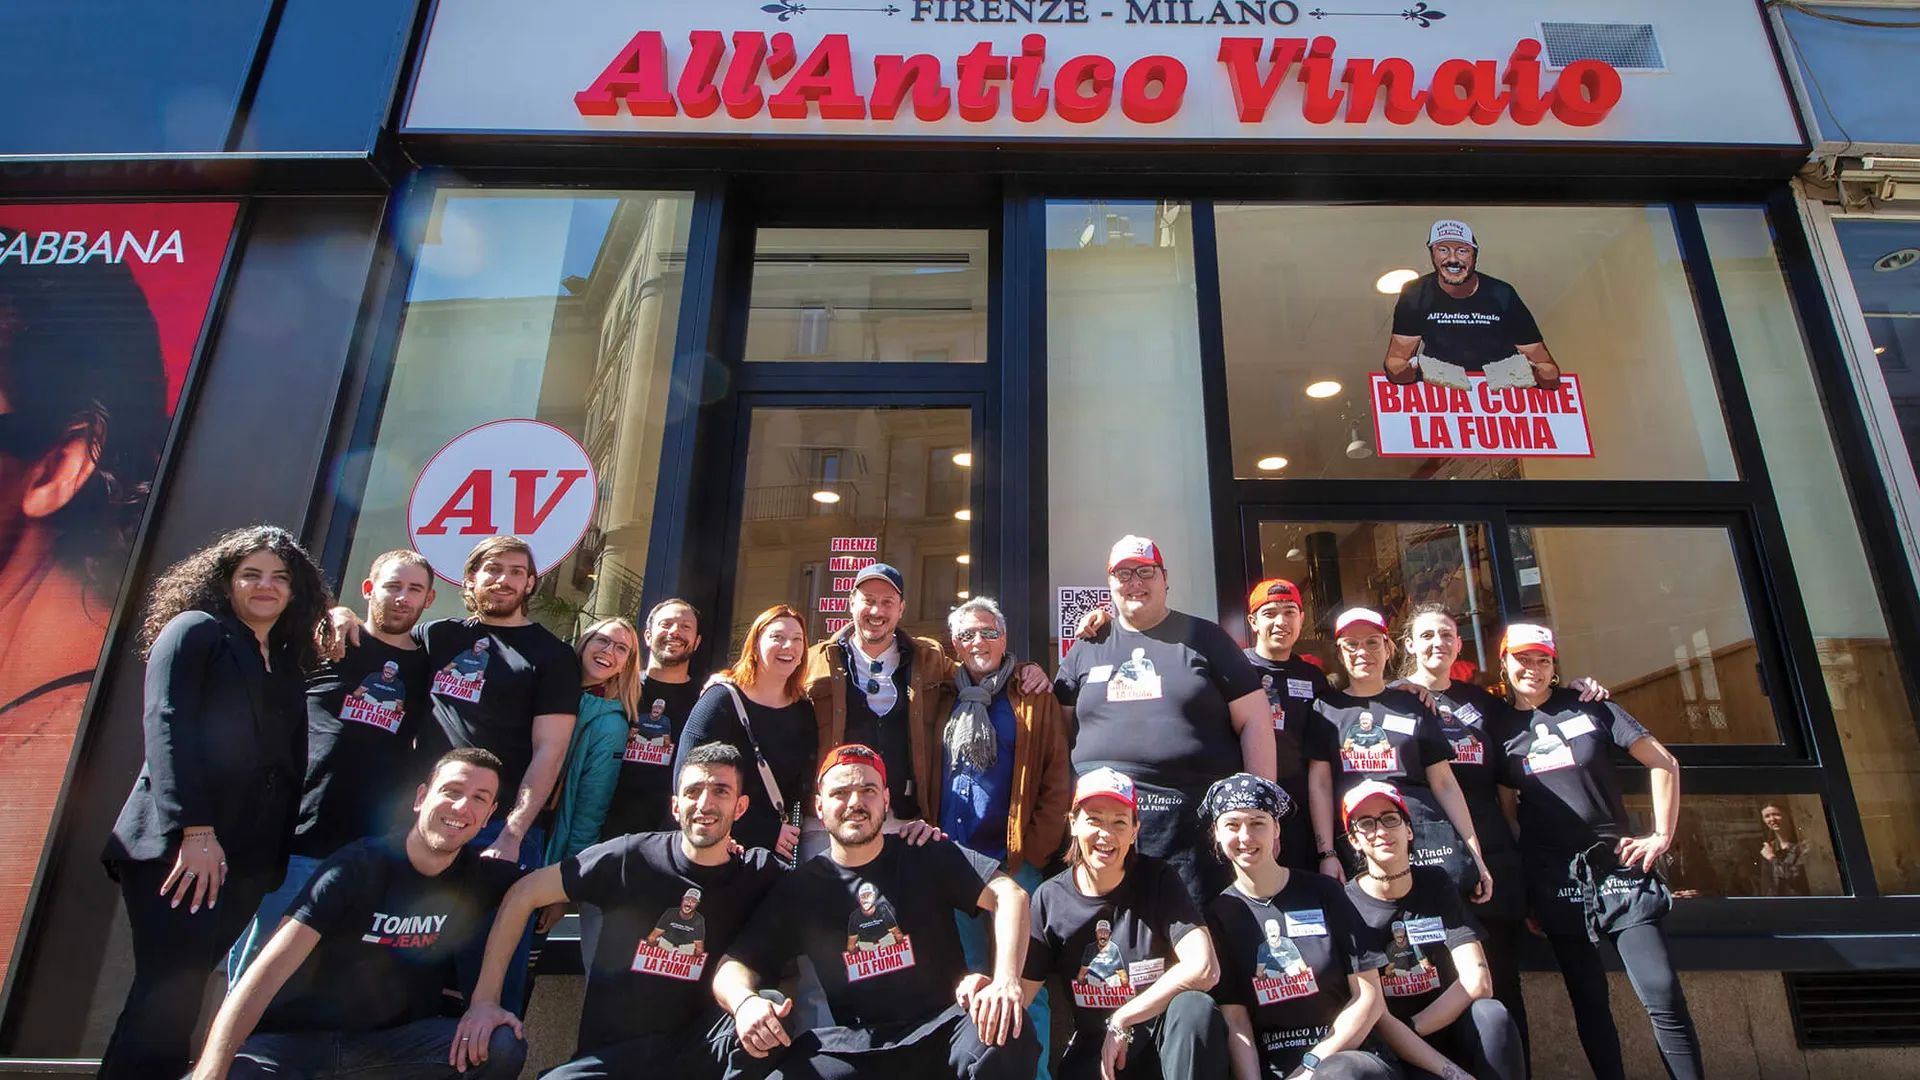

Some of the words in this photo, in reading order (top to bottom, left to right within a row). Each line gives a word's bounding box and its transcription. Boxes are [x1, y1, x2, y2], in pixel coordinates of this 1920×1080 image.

[910, 0, 1090, 23] FIRENZE
[1125, 0, 1300, 25] MILANO
[574, 30, 1188, 124] All'Antico
[1217, 36, 1623, 127] Vinaio
[1377, 381, 1473, 414] BADA
[1410, 416, 1453, 449] LA
[1457, 416, 1558, 449] FUMA
[416, 469, 588, 535] AV
[831, 537, 877, 551] FIRENZE
[819, 598, 847, 612] NEW
[1147, 794, 1183, 805] Vinaio
[1416, 846, 1453, 859] Vinaio
[372, 912, 448, 934] TOMMY
[1284, 1038, 1306, 1048] COME
